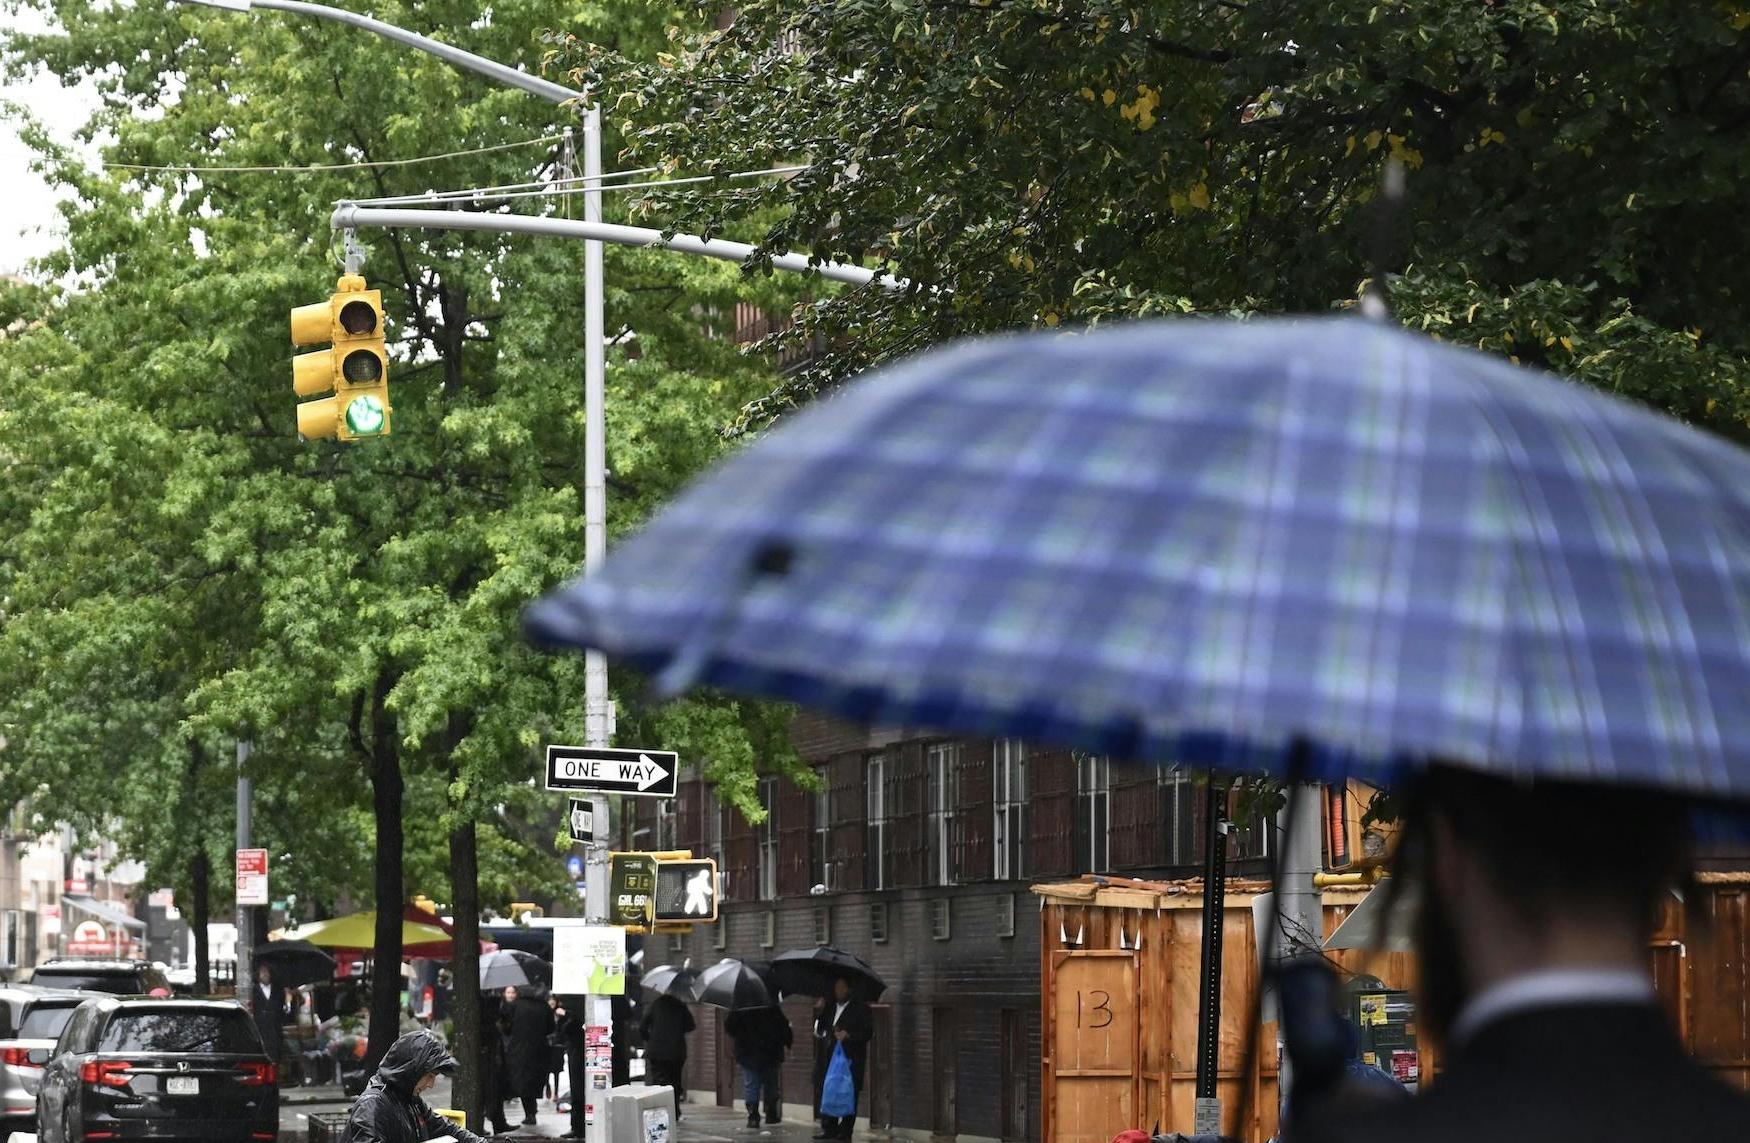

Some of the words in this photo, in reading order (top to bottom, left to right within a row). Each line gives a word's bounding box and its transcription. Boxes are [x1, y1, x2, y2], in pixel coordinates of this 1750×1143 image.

[565, 761, 600, 778] ONE
[619, 763, 655, 780] WAY
[1077, 989, 1113, 1028] 13
